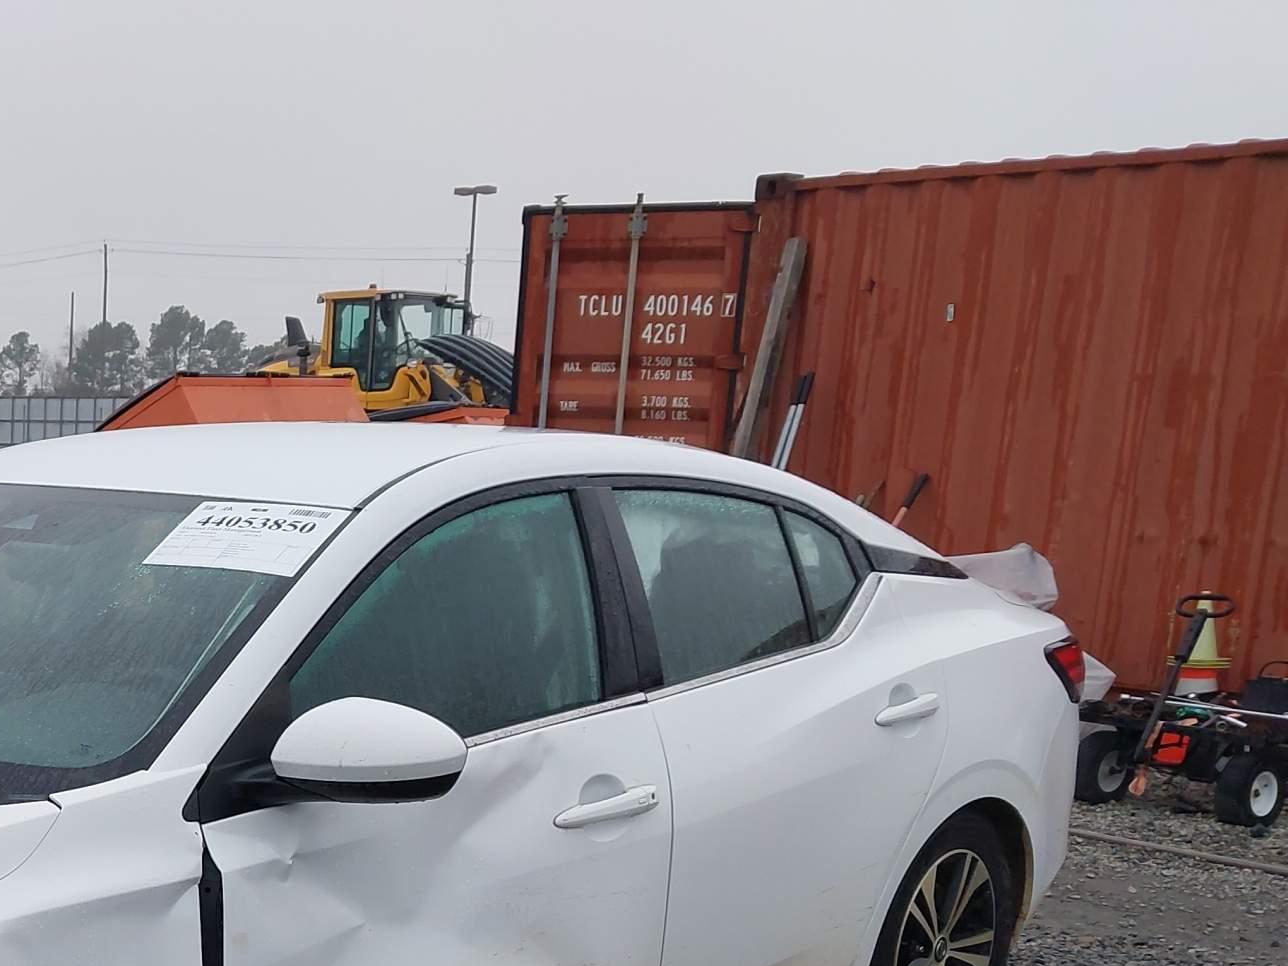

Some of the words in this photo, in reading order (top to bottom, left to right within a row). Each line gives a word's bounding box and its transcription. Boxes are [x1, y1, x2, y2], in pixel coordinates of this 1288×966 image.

[578, 294, 623, 317] TCLU
[643, 294, 714, 317] 400146
[723, 294, 736, 316] 7
[641, 322, 687, 345] 42G1
[591, 361, 617, 373] GROSS
[641, 356, 672, 367] 32.500
[640, 369, 671, 380] 71.650
[641, 395, 667, 407] 3.700
[197, 514, 317, 534] 44053850
